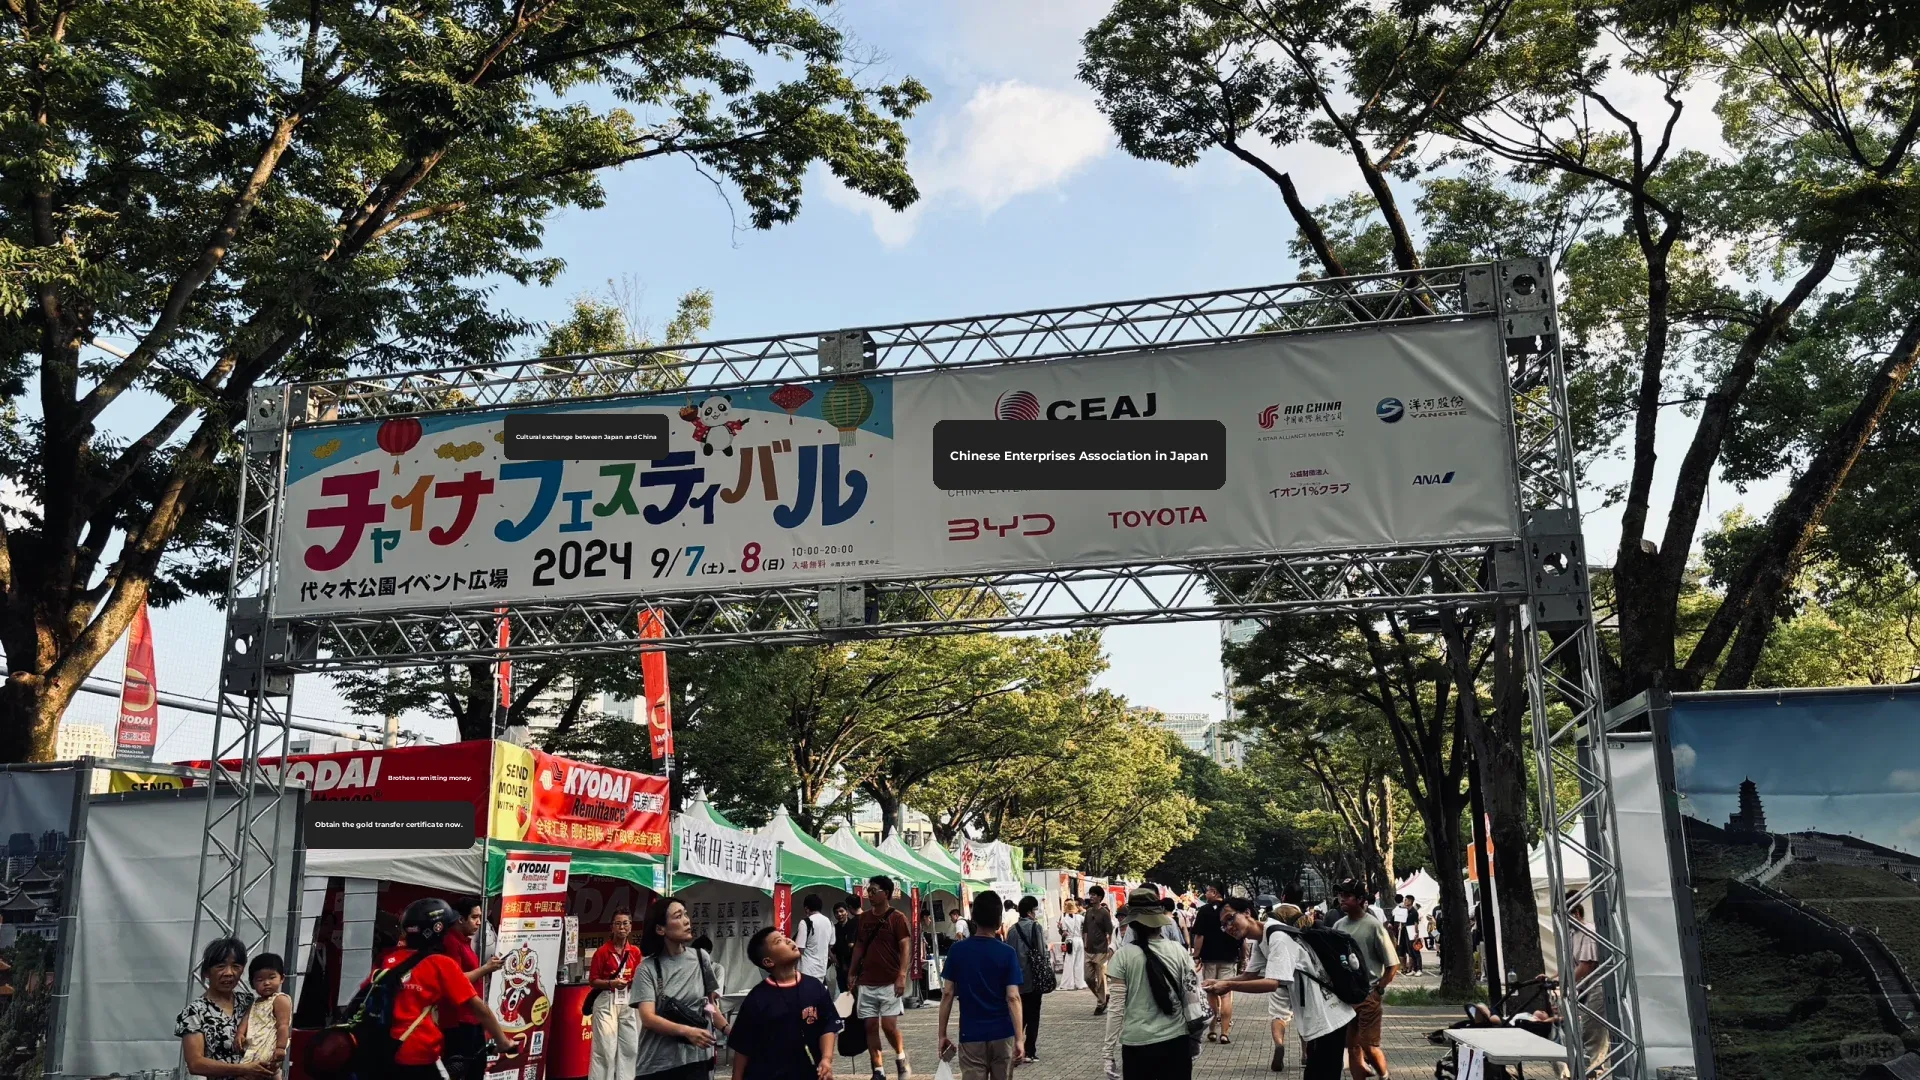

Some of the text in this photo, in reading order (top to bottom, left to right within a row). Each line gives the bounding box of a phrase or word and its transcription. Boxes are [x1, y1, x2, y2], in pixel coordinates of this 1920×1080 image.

[1046, 392, 1157, 420] CEAJ
[1284, 400, 1342, 415] AIR CHINA
[1408, 395, 1465, 410] 洋河股份
[1410, 410, 1468, 419] YANGHE
[1412, 474, 1441, 486] ANA
[1268, 482, 1352, 499] イオン1%クラブ
[303, 438, 869, 572] チャイナフェスティバル
[1107, 505, 1208, 530] TOYOTA
[947, 513, 1056, 541] BYD
[531, 538, 633, 587] 2024
[791, 559, 827, 570] 入場無料
[300, 568, 509, 603] 代々木公園イベント広場
[506, 763, 529, 781] SEND
[498, 781, 528, 799] MONEY
[563, 765, 632, 804] KYODAI
[497, 800, 515, 811] WITH
[517, 862, 551, 874] KYODAI
